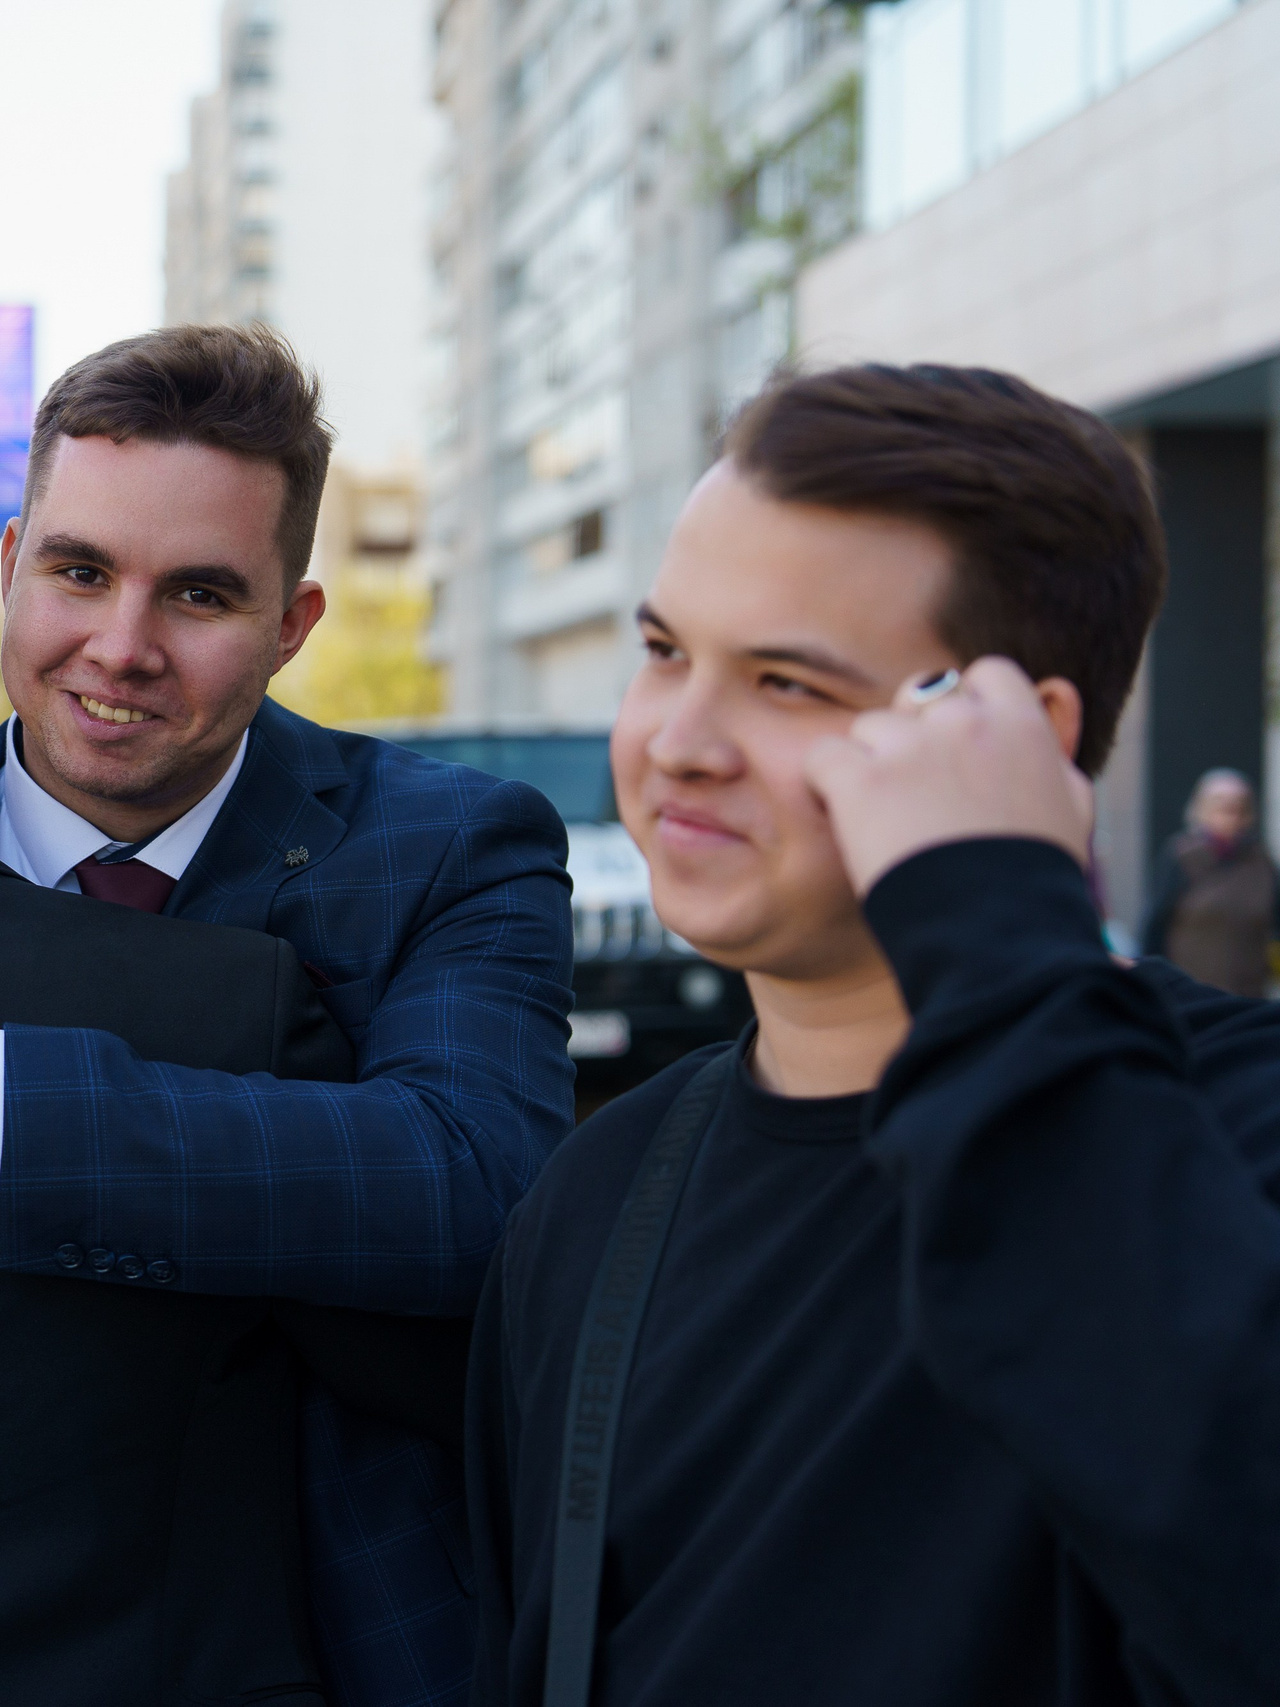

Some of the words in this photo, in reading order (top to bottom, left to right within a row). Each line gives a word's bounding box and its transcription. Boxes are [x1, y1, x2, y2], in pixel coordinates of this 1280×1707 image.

[595, 1308, 631, 1335] A
[583, 1336, 623, 1378] IS
[572, 1378, 614, 1456] LIFE
[565, 1462, 599, 1522] MY
